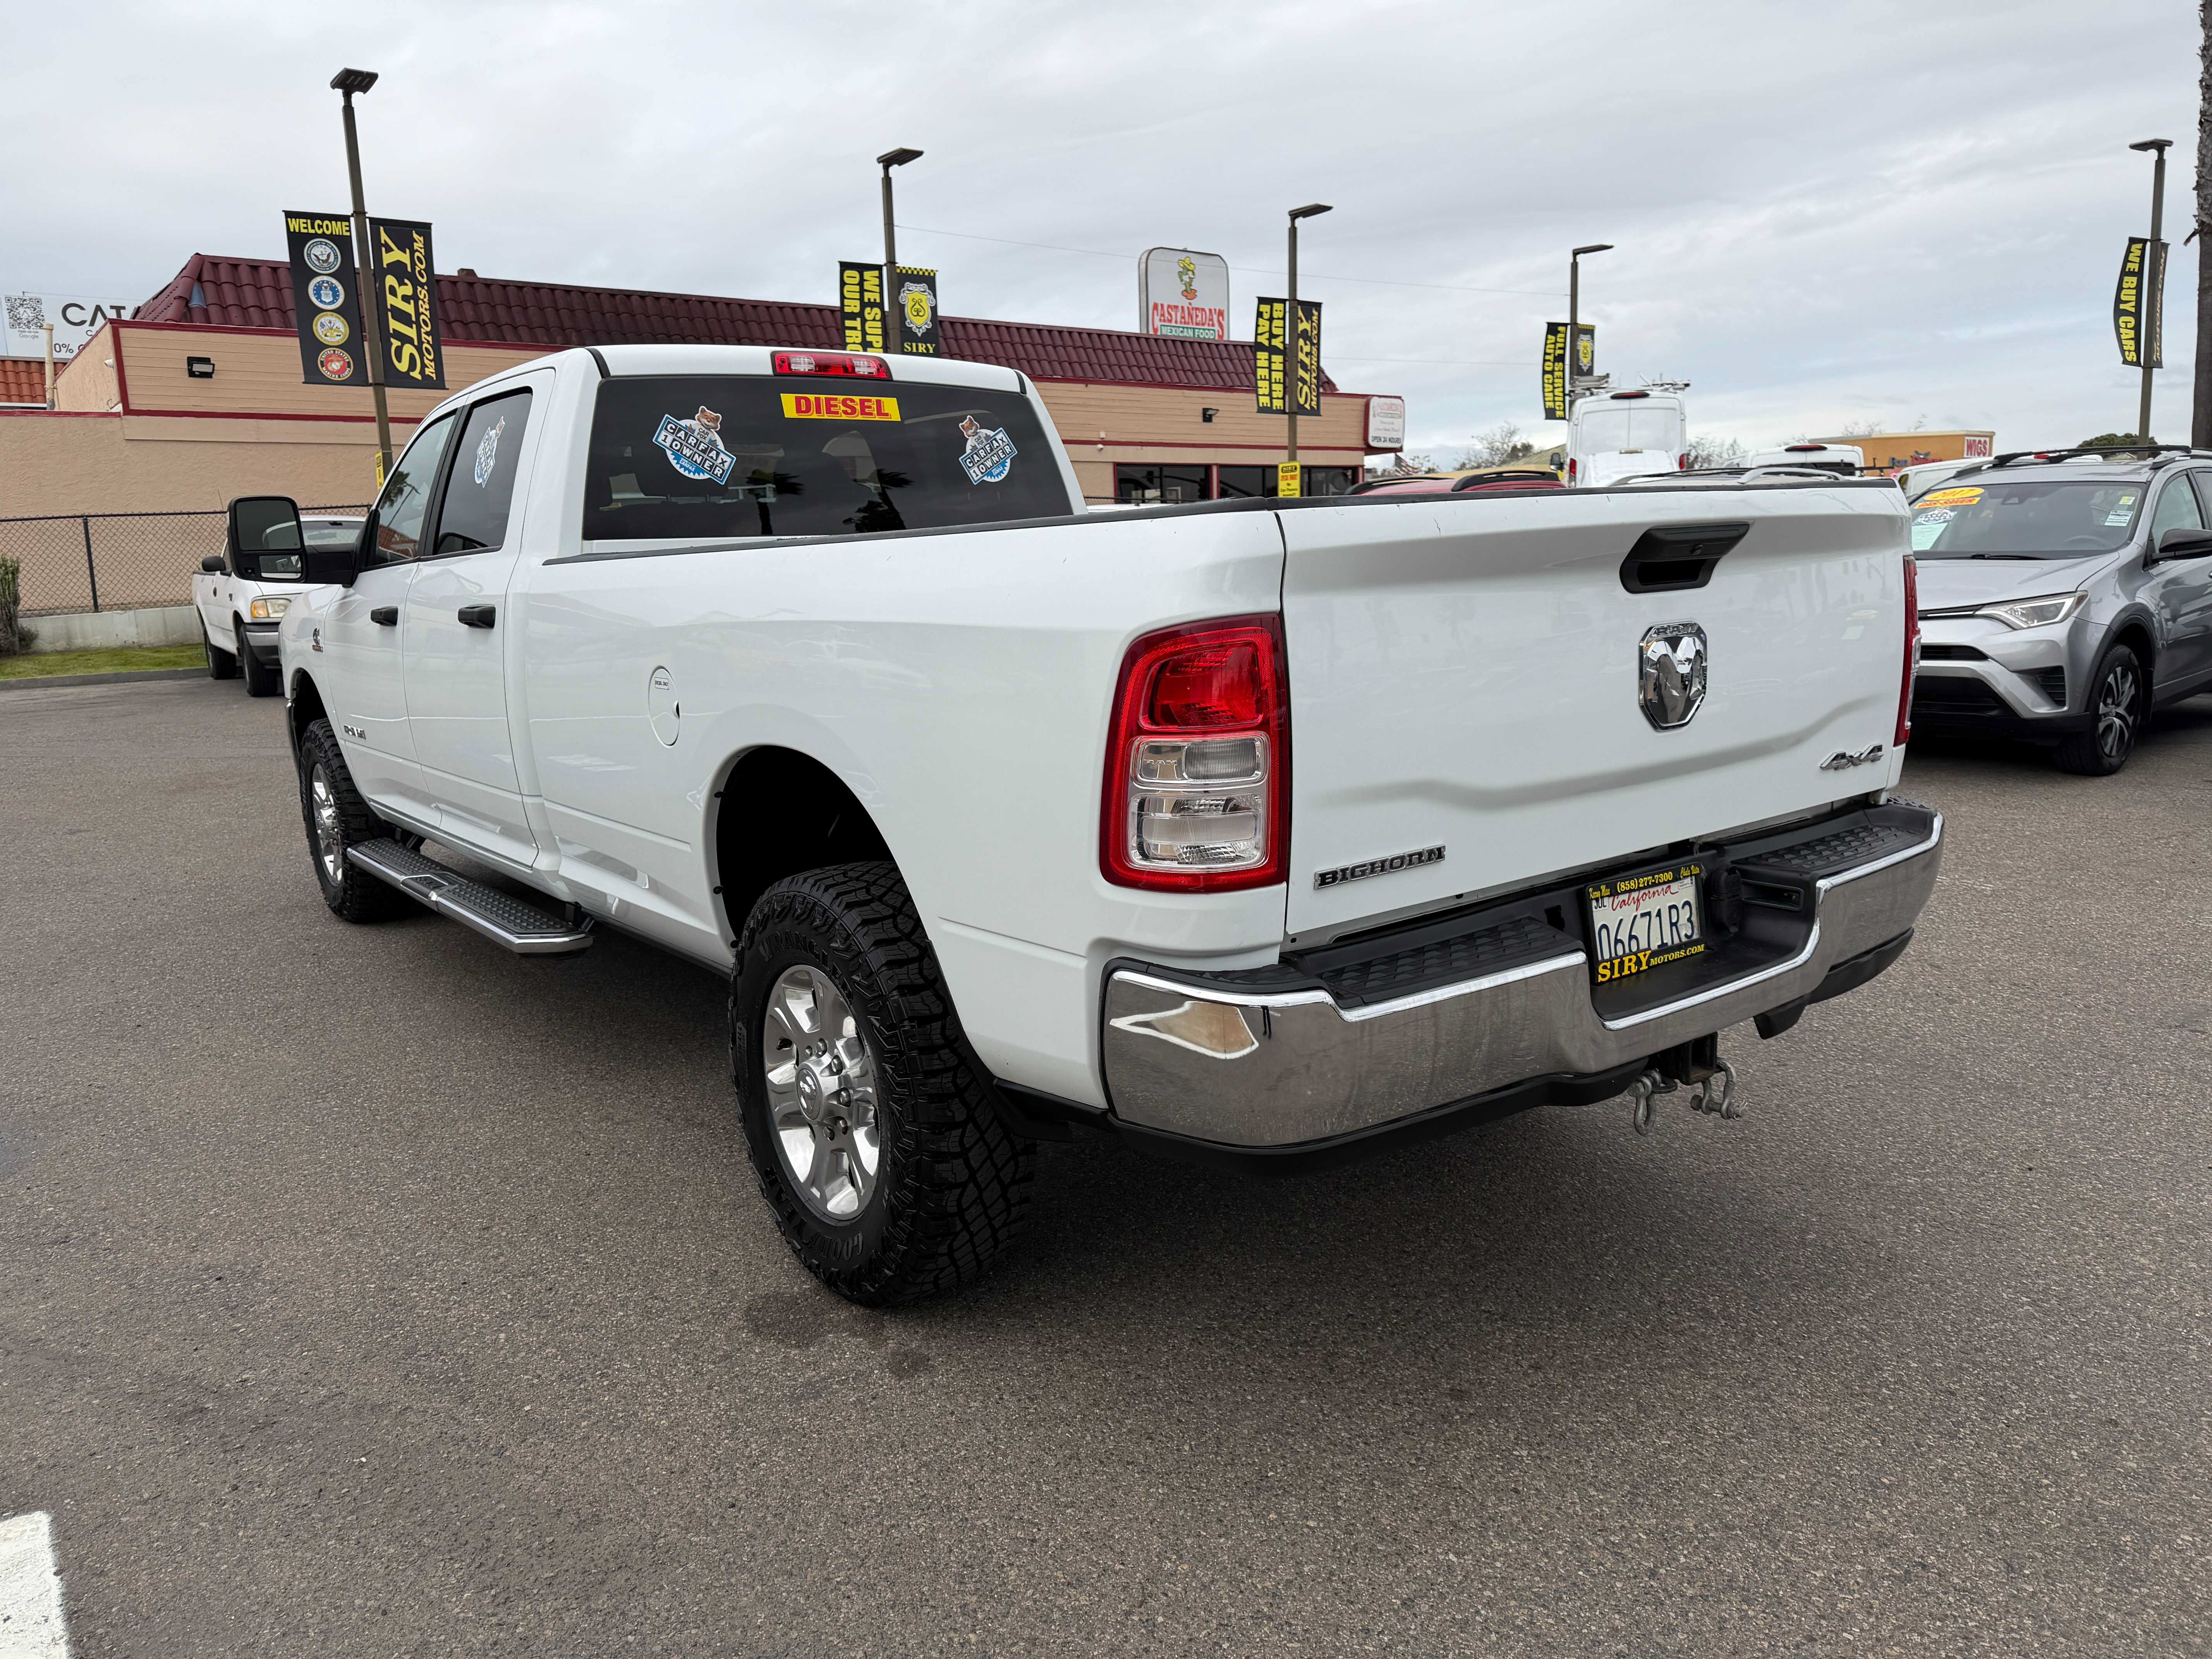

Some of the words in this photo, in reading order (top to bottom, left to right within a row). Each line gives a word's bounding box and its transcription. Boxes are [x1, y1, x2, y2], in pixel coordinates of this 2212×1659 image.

[288, 218, 350, 236] WELCOME
[2125, 243, 2143, 272] WE
[380, 226, 422, 380] SIRY
[843, 270, 860, 313] OUR
[863, 270, 880, 303] WE
[2119, 276, 2137, 313] BUY
[412, 230, 436, 380] MOTORS.COM
[1161, 326, 1194, 337] MEXICAN
[1194, 329, 1215, 339] FOOD
[1257, 304, 1271, 347] PAY
[1271, 303, 1284, 350] BUY
[1555, 326, 1566, 356] FULL
[2119, 316, 2136, 362] CARS
[903, 342, 936, 354] SIRY
[1298, 305, 1311, 410] SIRY
[1544, 335, 1555, 371] AUTO
[322, 366, 339, 378] MARINE
[1256, 352, 1271, 407] HERE
[1271, 355, 1284, 410] HERE
[1554, 362, 1565, 418] SERVICE
[795, 396, 891, 419] DIESEL
[1544, 374, 1554, 409] CARE
[667, 423, 727, 468] CARFAX
[697, 432, 707, 441] FOX
[698, 428, 709, 436] CAR
[1966, 439, 1988, 456] WIGS
[966, 436, 1006, 467] CARFAX
[1314, 844, 1446, 890] BIGHORN
[1617, 878, 1638, 893] (858)
[1639, 871, 1673, 888] 277-7300
[1611, 884, 1679, 912] California
[1598, 950, 1652, 983] SIRY
[1649, 944, 1705, 966] MOTORS.COM
[764, 1163, 863, 1262] GOODYEAR
